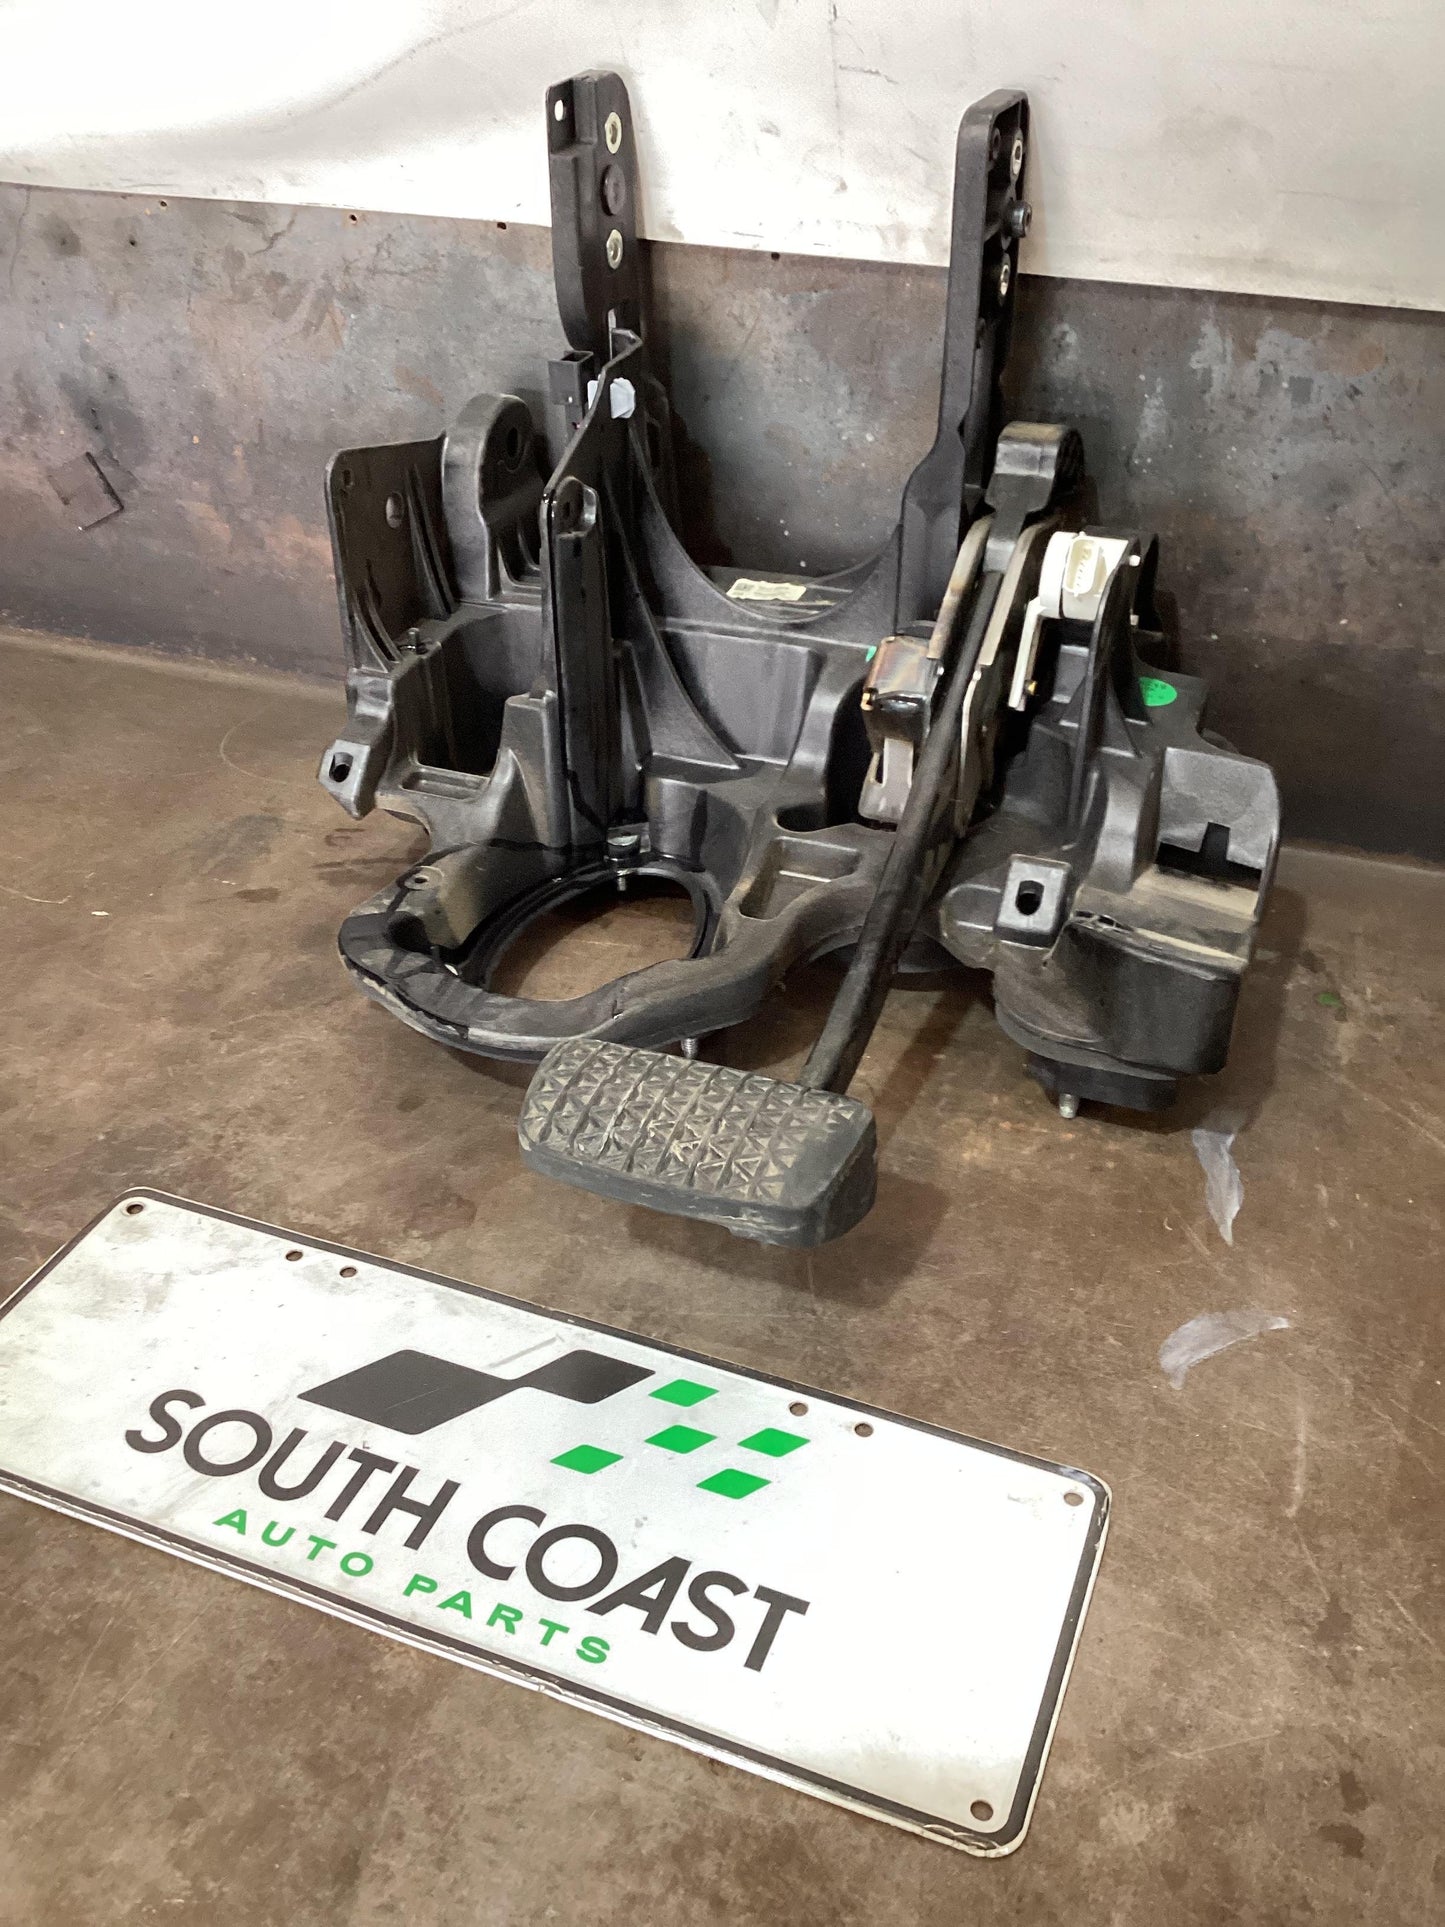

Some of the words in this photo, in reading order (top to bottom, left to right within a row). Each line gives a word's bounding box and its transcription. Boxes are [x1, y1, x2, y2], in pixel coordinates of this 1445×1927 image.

[125, 1389, 461, 1550] SOUTH
[467, 1504, 810, 1672] COAST
[213, 1508, 374, 1577] AUTO
[403, 1573, 611, 1664] PARTS
